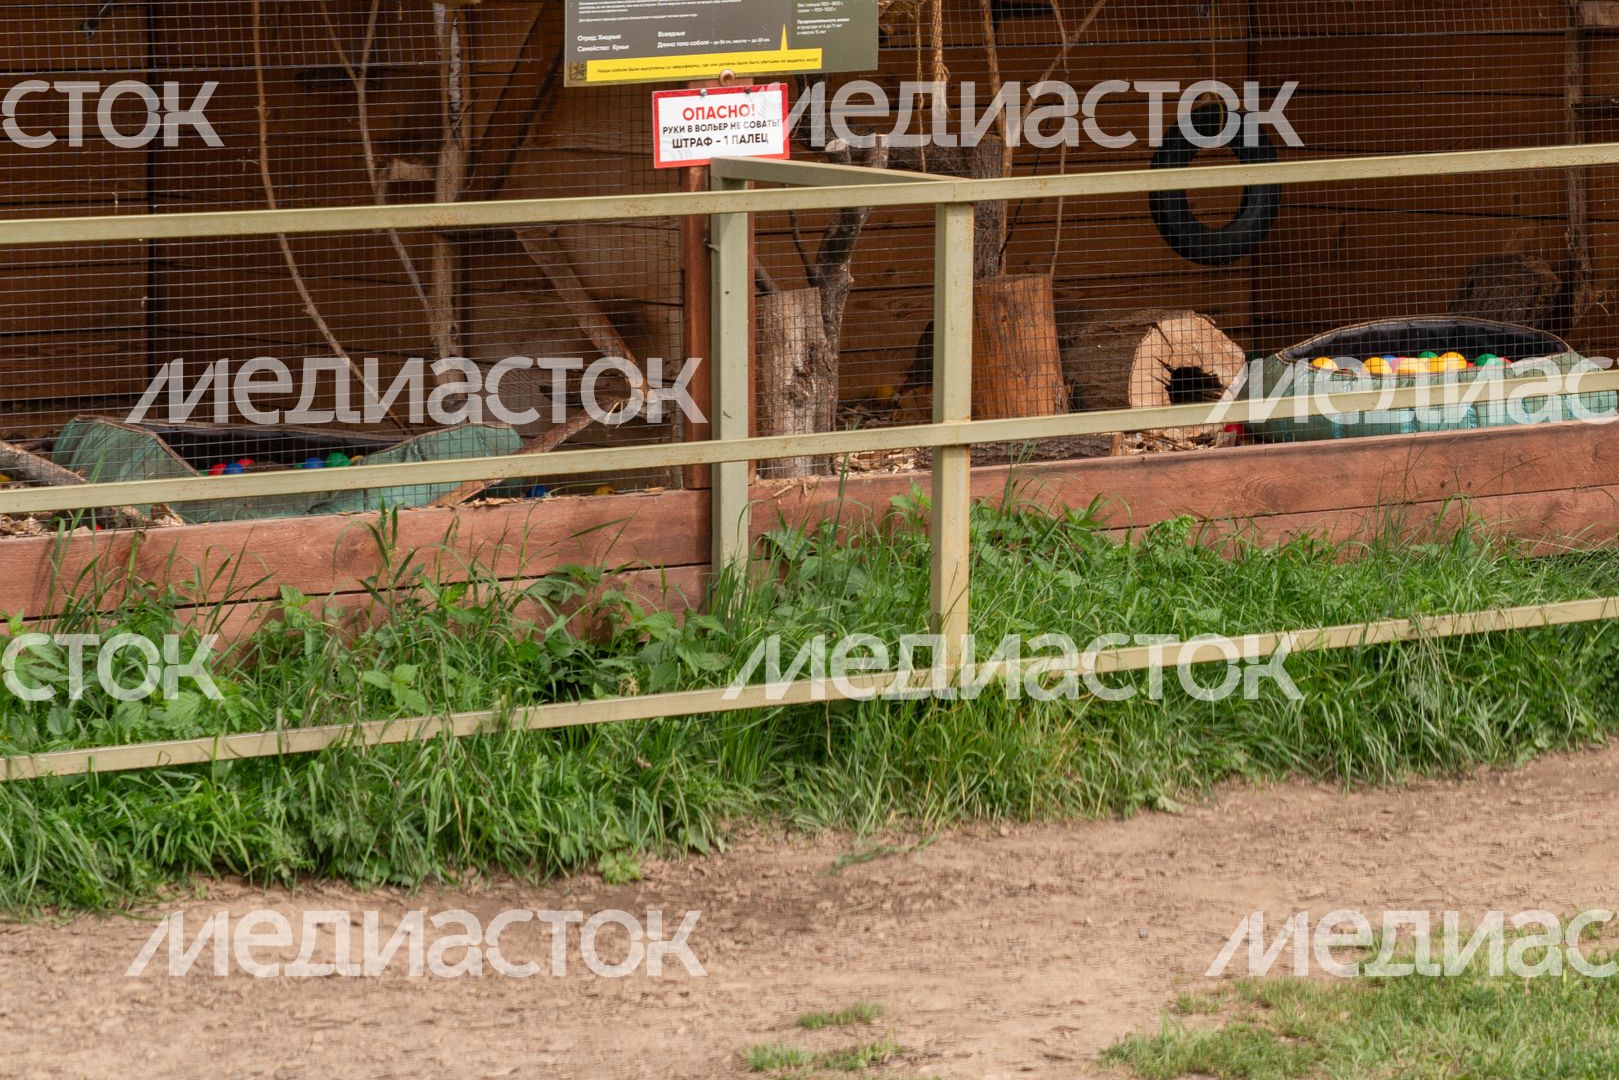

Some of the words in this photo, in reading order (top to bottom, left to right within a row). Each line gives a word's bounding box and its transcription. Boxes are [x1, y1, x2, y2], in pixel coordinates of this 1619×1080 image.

[682, 104, 755, 121] ОПАСНО!
[663, 126, 685, 135] РУКИ
[688, 125, 693, 133] В
[695, 123, 727, 132] ВОЛЬЕР
[730, 122, 741, 130] НЕ
[743, 120, 780, 129] СОВАТЬ!
[672, 137, 713, 149] ШТРАФ
[724, 136, 729, 145] 1
[732, 133, 769, 145] ПАЛЕЦ
